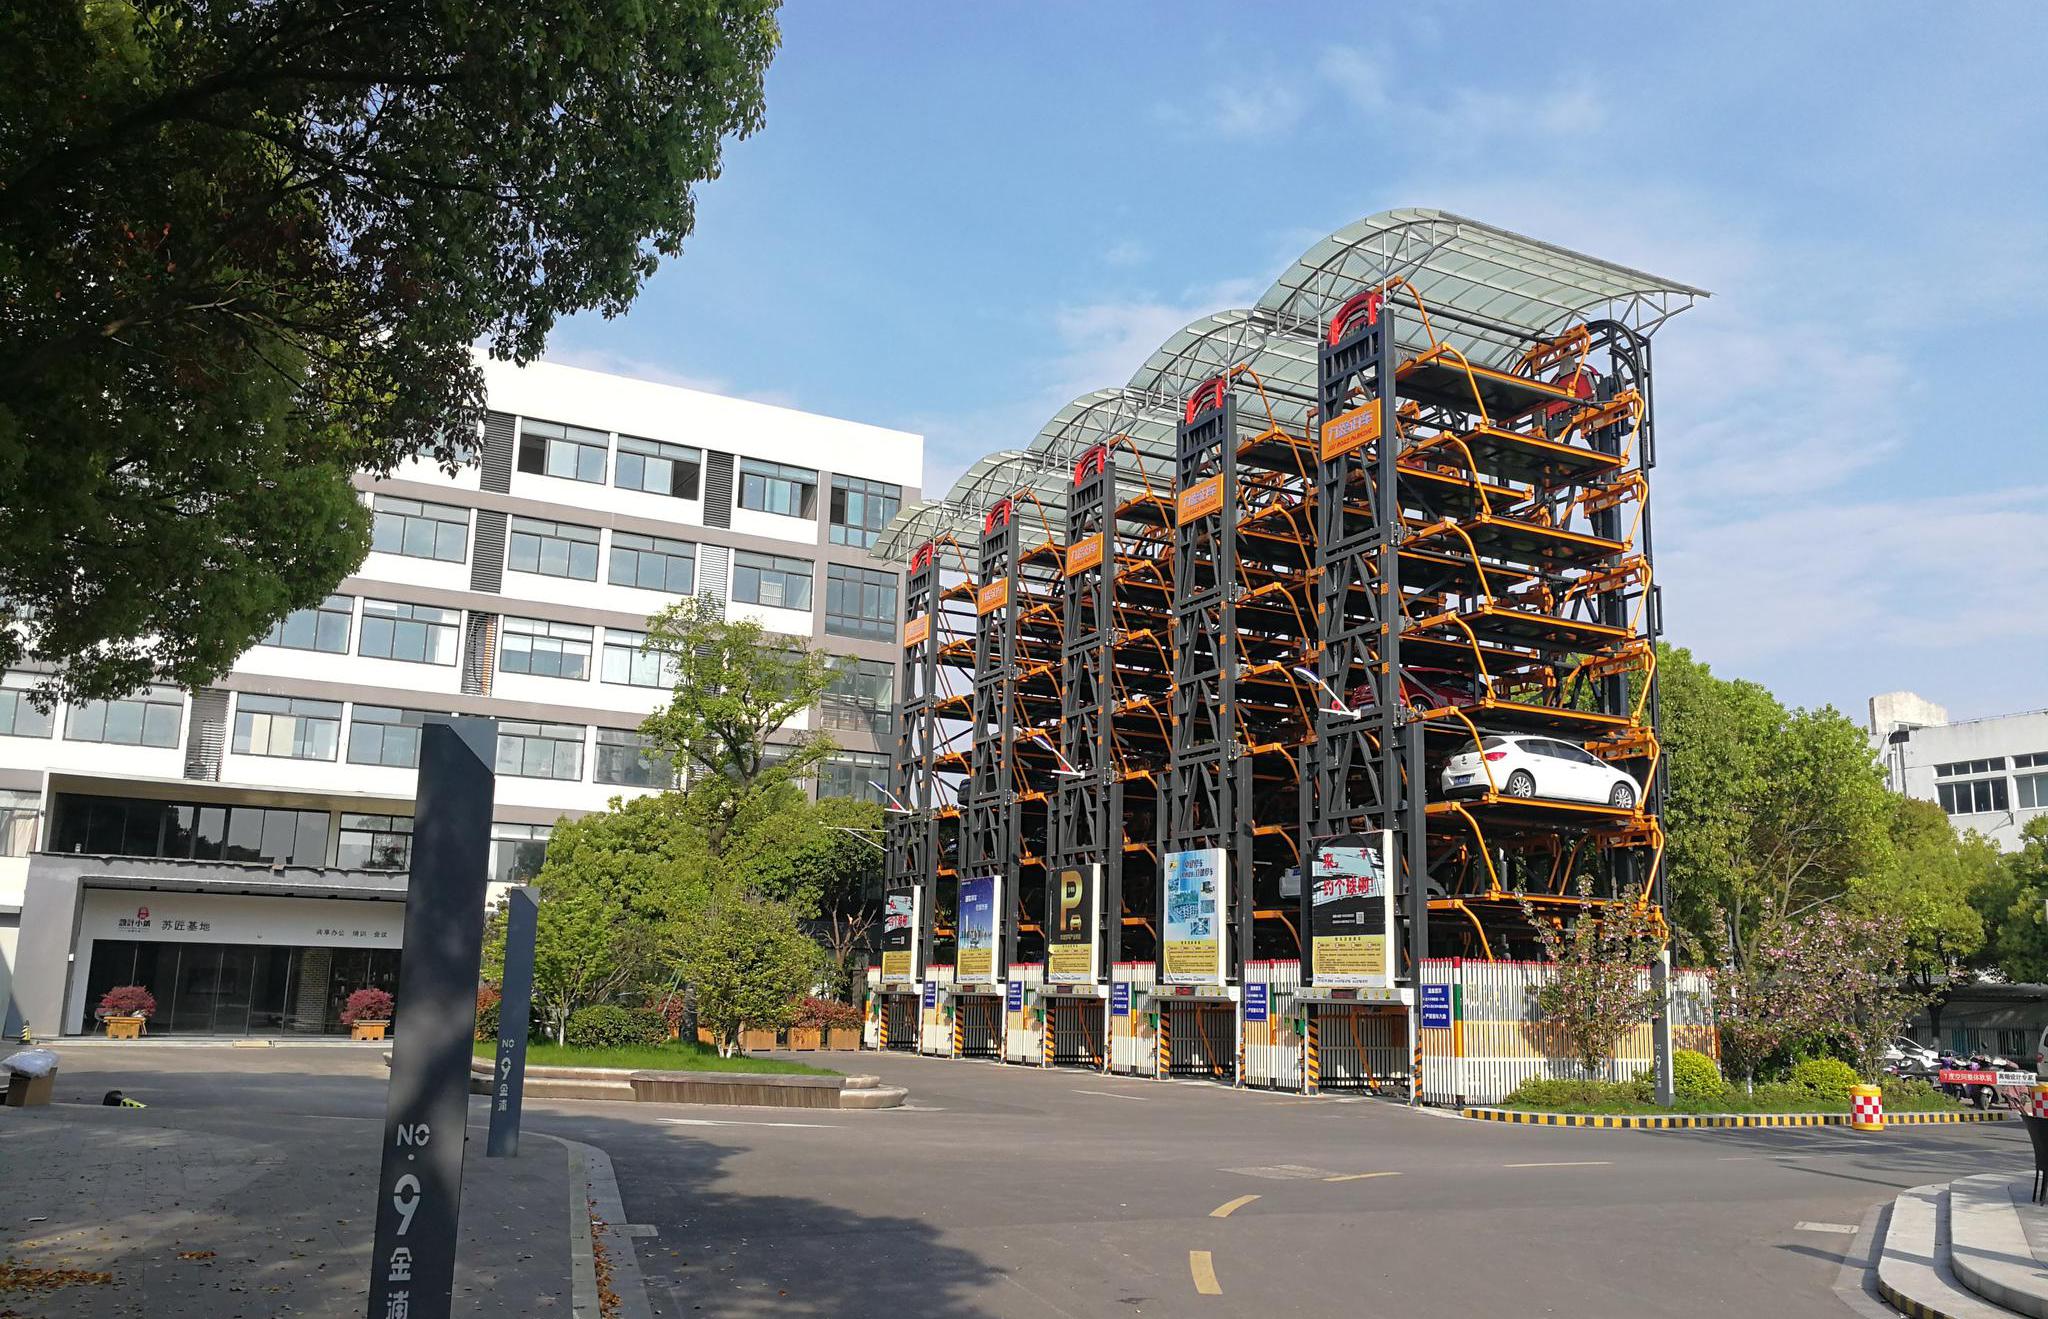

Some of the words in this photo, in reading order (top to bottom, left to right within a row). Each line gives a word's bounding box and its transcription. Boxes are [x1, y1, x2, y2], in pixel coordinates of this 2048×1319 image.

[161, 920, 211, 931] 苏匠基地
[500, 1057, 511, 1080] 9
[393, 1173, 421, 1236] 9
